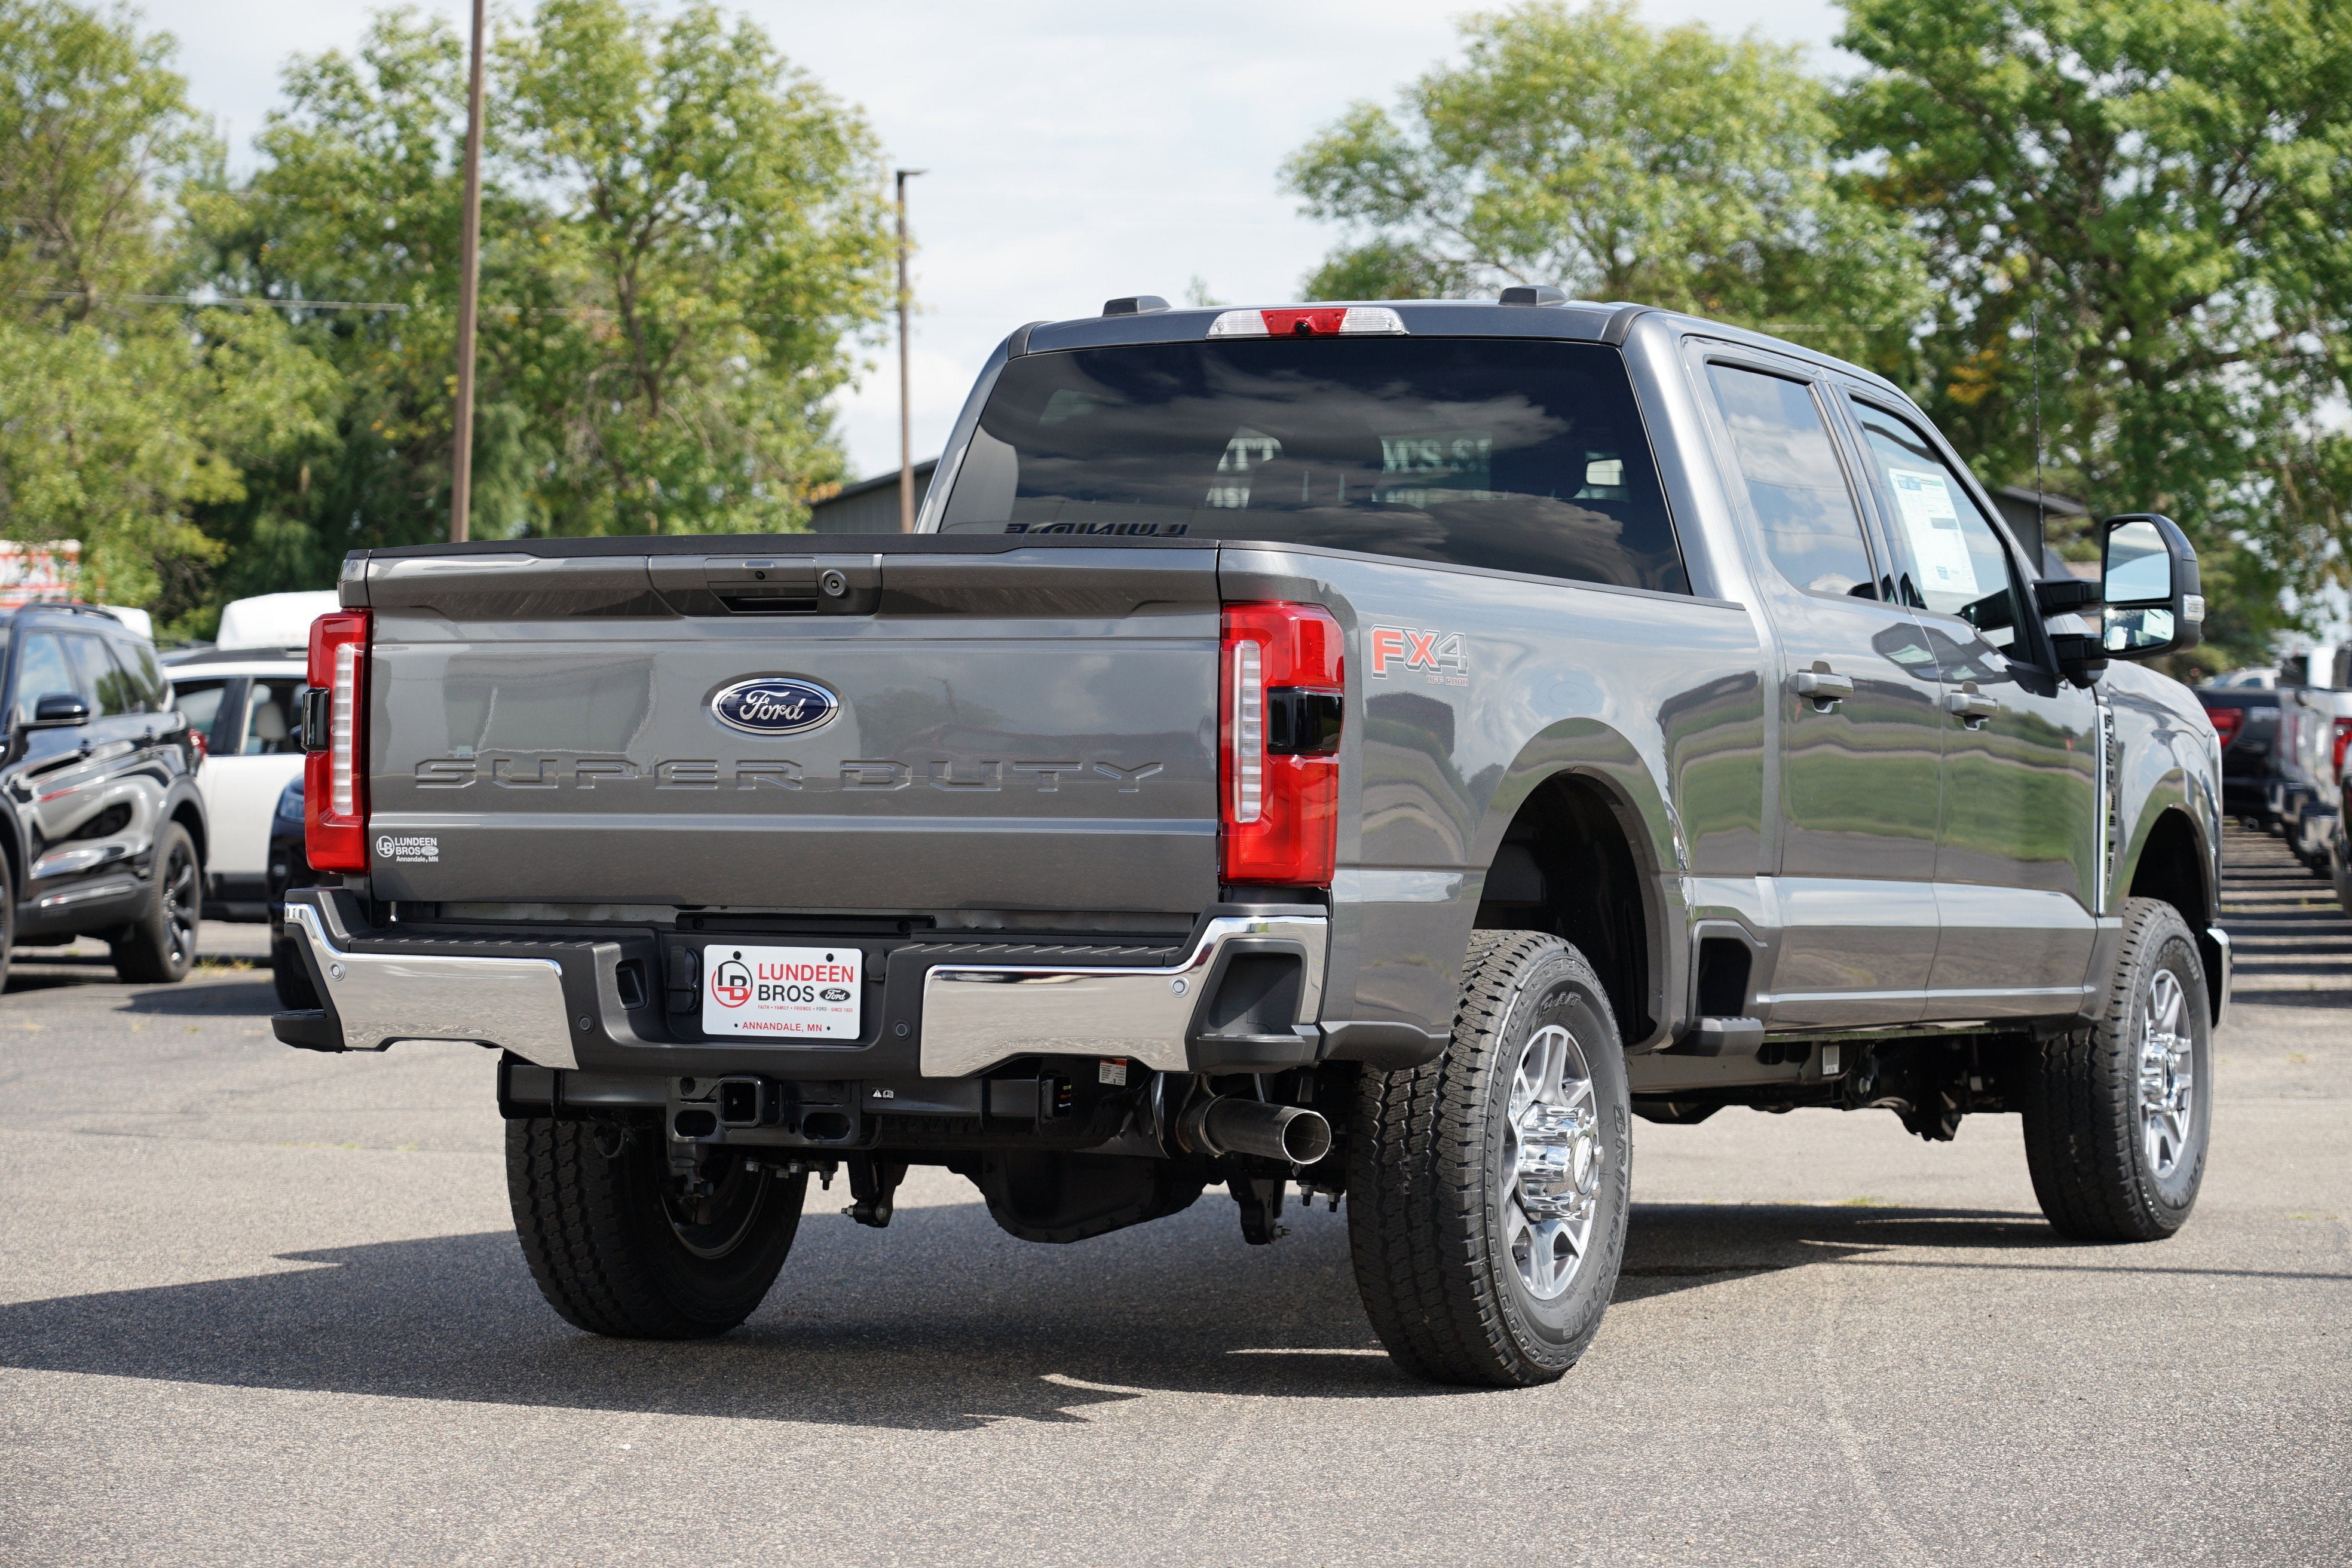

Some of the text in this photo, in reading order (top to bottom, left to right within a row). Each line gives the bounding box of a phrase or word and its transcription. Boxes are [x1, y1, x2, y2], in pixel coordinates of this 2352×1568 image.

[1370, 624, 1469, 680] FX4
[1426, 675, 1469, 687] OFF ROAD
[739, 690, 807, 721] Ford
[413, 757, 1165, 794] SUPER DUTY
[394, 837, 437, 846] LUNDEEN
[396, 847, 421, 855] BROS
[758, 963, 854, 983] LUNDEEN
[758, 984, 846, 1003] BROS Ford
[742, 1021, 822, 1033] ANNANDALE, MN
[1563, 1104, 1627, 1339] BRIDGESTONE
